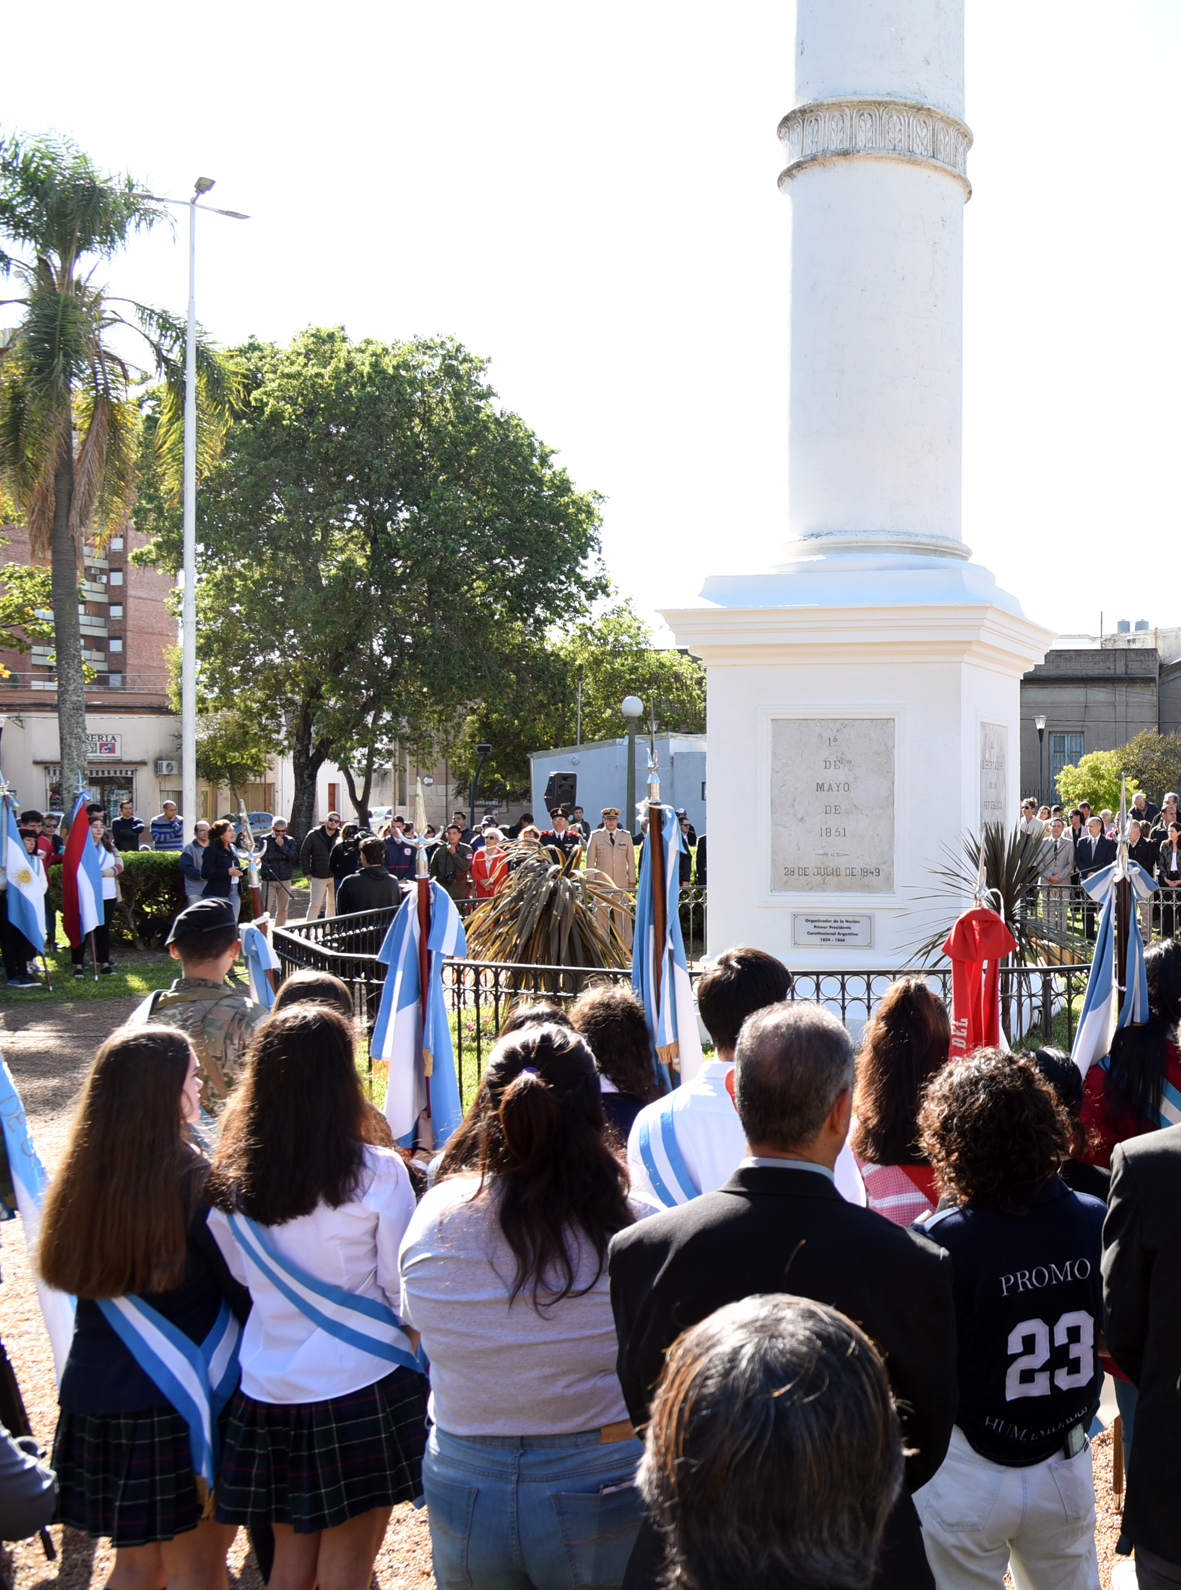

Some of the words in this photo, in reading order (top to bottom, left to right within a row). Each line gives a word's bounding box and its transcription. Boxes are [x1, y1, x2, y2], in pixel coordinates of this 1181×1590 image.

[823, 760, 841, 770] DE
[816, 782, 850, 793] MAYO
[824, 805, 841, 815] DE
[820, 827, 847, 837] 1851
[783, 866, 796, 877] 28
[797, 866, 810, 877] DE
[812, 867, 841, 877] JULIO
[844, 867, 857, 877] DE
[859, 867, 881, 877] 1849
[951, 1018, 969, 1050] DEL
[999, 1257, 1092, 1297] PROMO
[1005, 1309, 1095, 1402] 23
